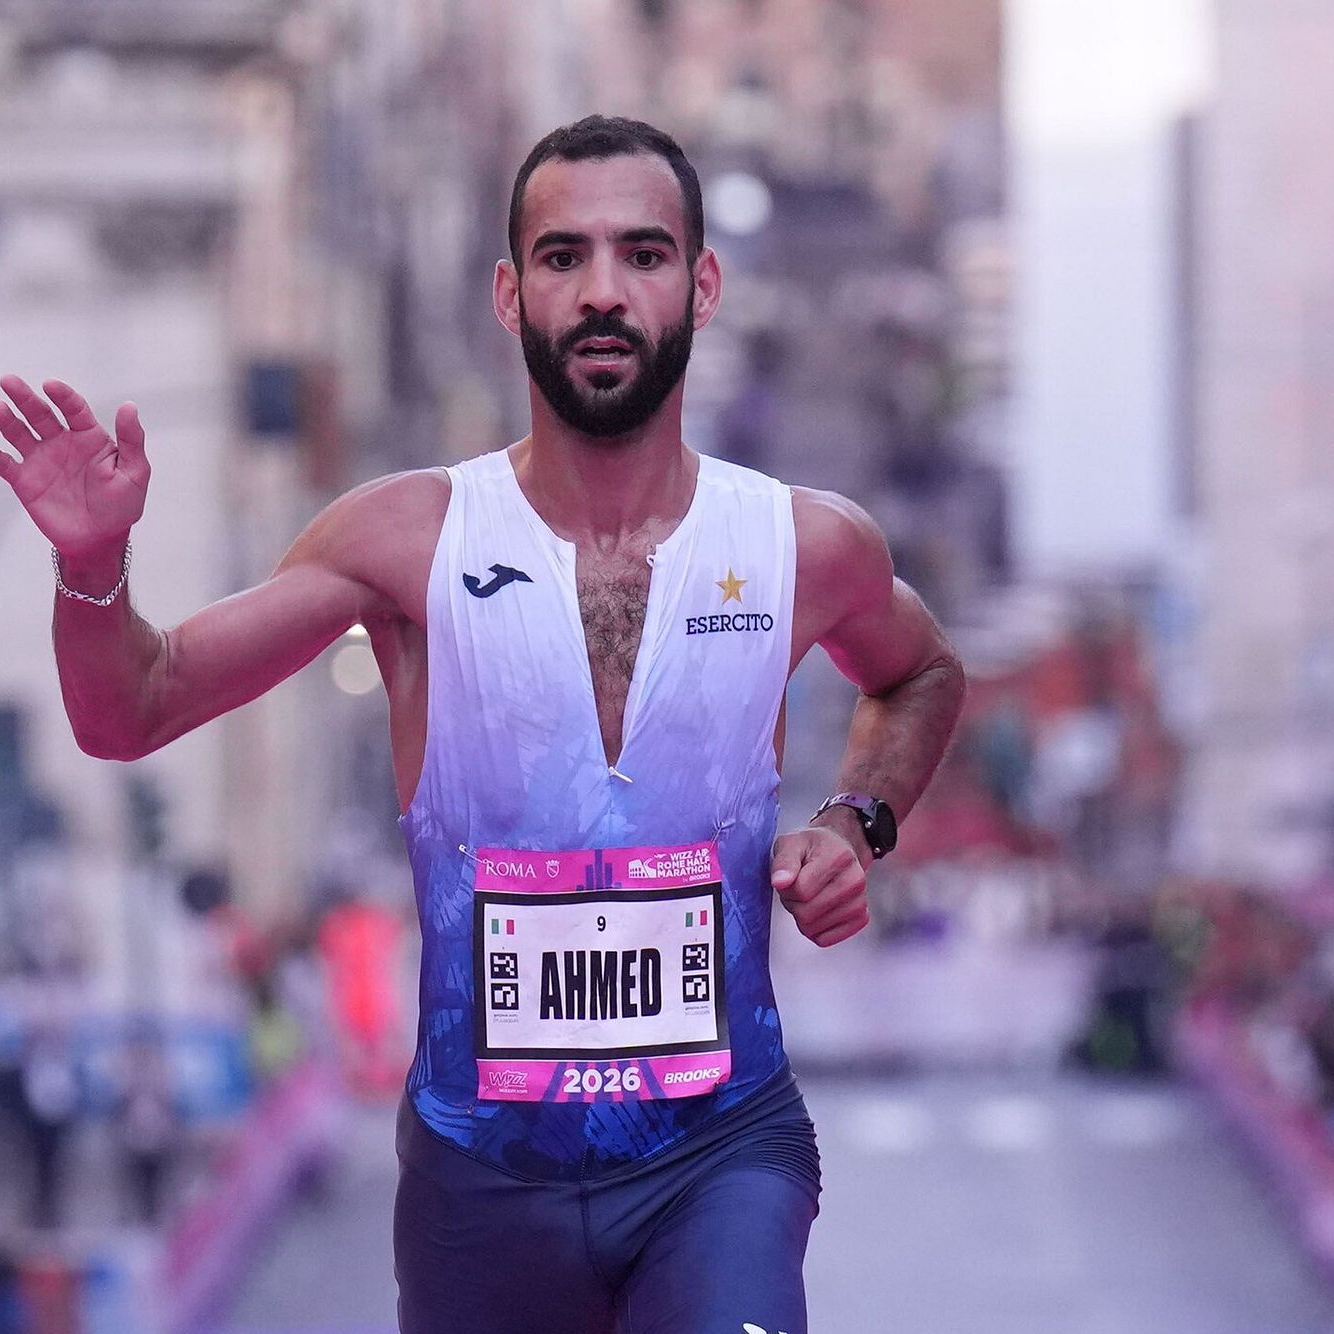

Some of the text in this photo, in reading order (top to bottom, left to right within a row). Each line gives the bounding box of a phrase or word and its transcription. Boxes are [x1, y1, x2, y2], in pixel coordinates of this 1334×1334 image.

[686, 613, 773, 635] ESERCITO
[657, 856, 710, 870] ROME HALF
[670, 851, 693, 861] WIZZ
[485, 860, 537, 879] ROMA
[657, 864, 711, 878] MARATHON
[597, 916, 606, 931] 9
[540, 948, 662, 1020] AHMED
[563, 1067, 641, 1093] 2026
[664, 1067, 722, 1084] BROOKS
